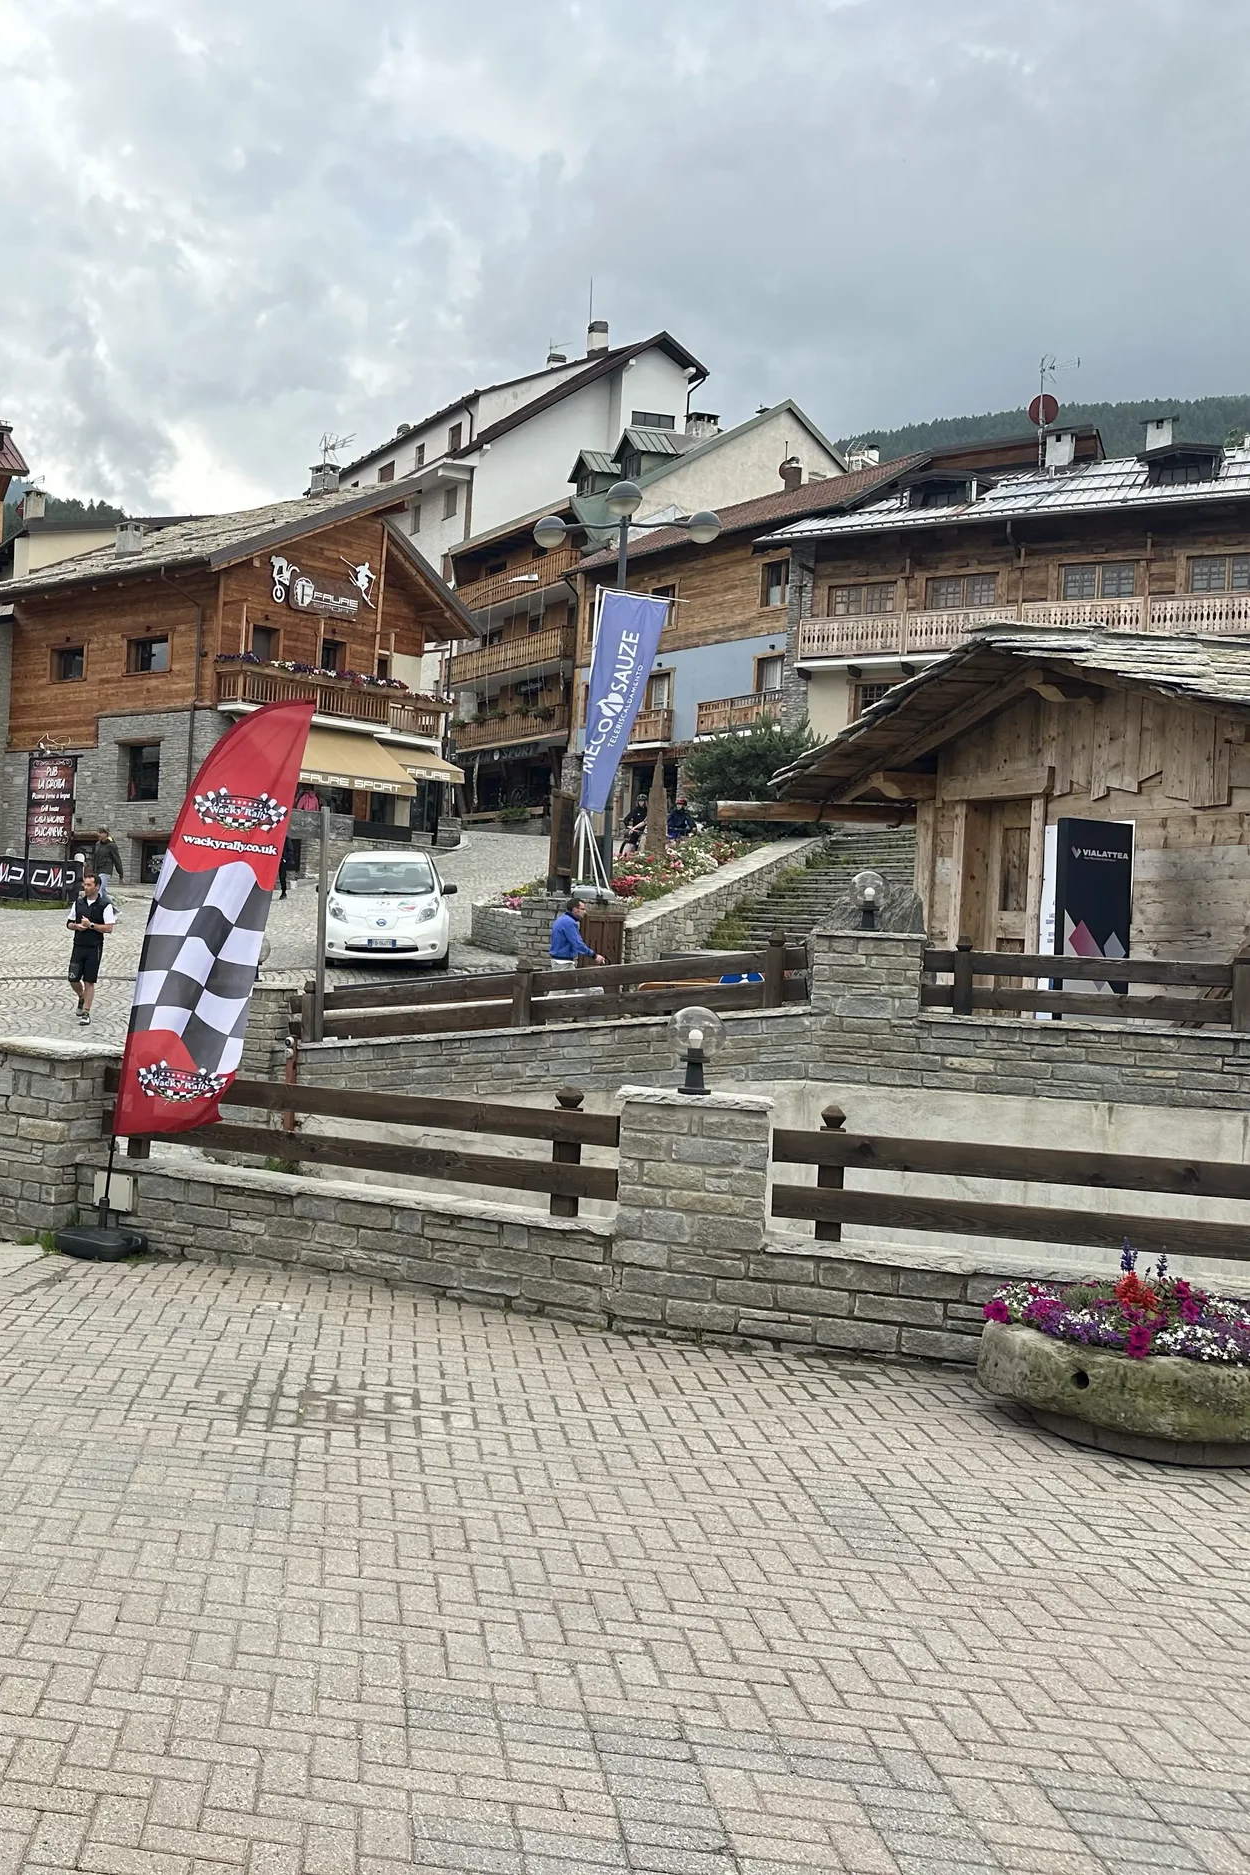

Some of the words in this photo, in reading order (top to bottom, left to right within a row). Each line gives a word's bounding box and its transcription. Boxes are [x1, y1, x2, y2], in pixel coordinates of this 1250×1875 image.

[314, 591, 359, 608] FAURE
[583, 717, 614, 775] MECO
[611, 629, 640, 693] SAUZE
[607, 664, 644, 748] TELERISCALDAMENTO
[46, 766, 58, 777] PUB
[407, 767, 451, 780] FAURE
[299, 772, 350, 787] FAURE
[354, 779, 402, 793] SPORT
[210, 805, 242, 816] Wacky
[244, 807, 269, 820] Rally
[34, 826, 64, 837] BUCANEVE
[182, 834, 278, 856] wackyrally.co.uk
[1082, 848, 1129, 860] VIALATTEA
[30, 867, 76, 888] CMP
[151, 1078, 182, 1089] Wacky
